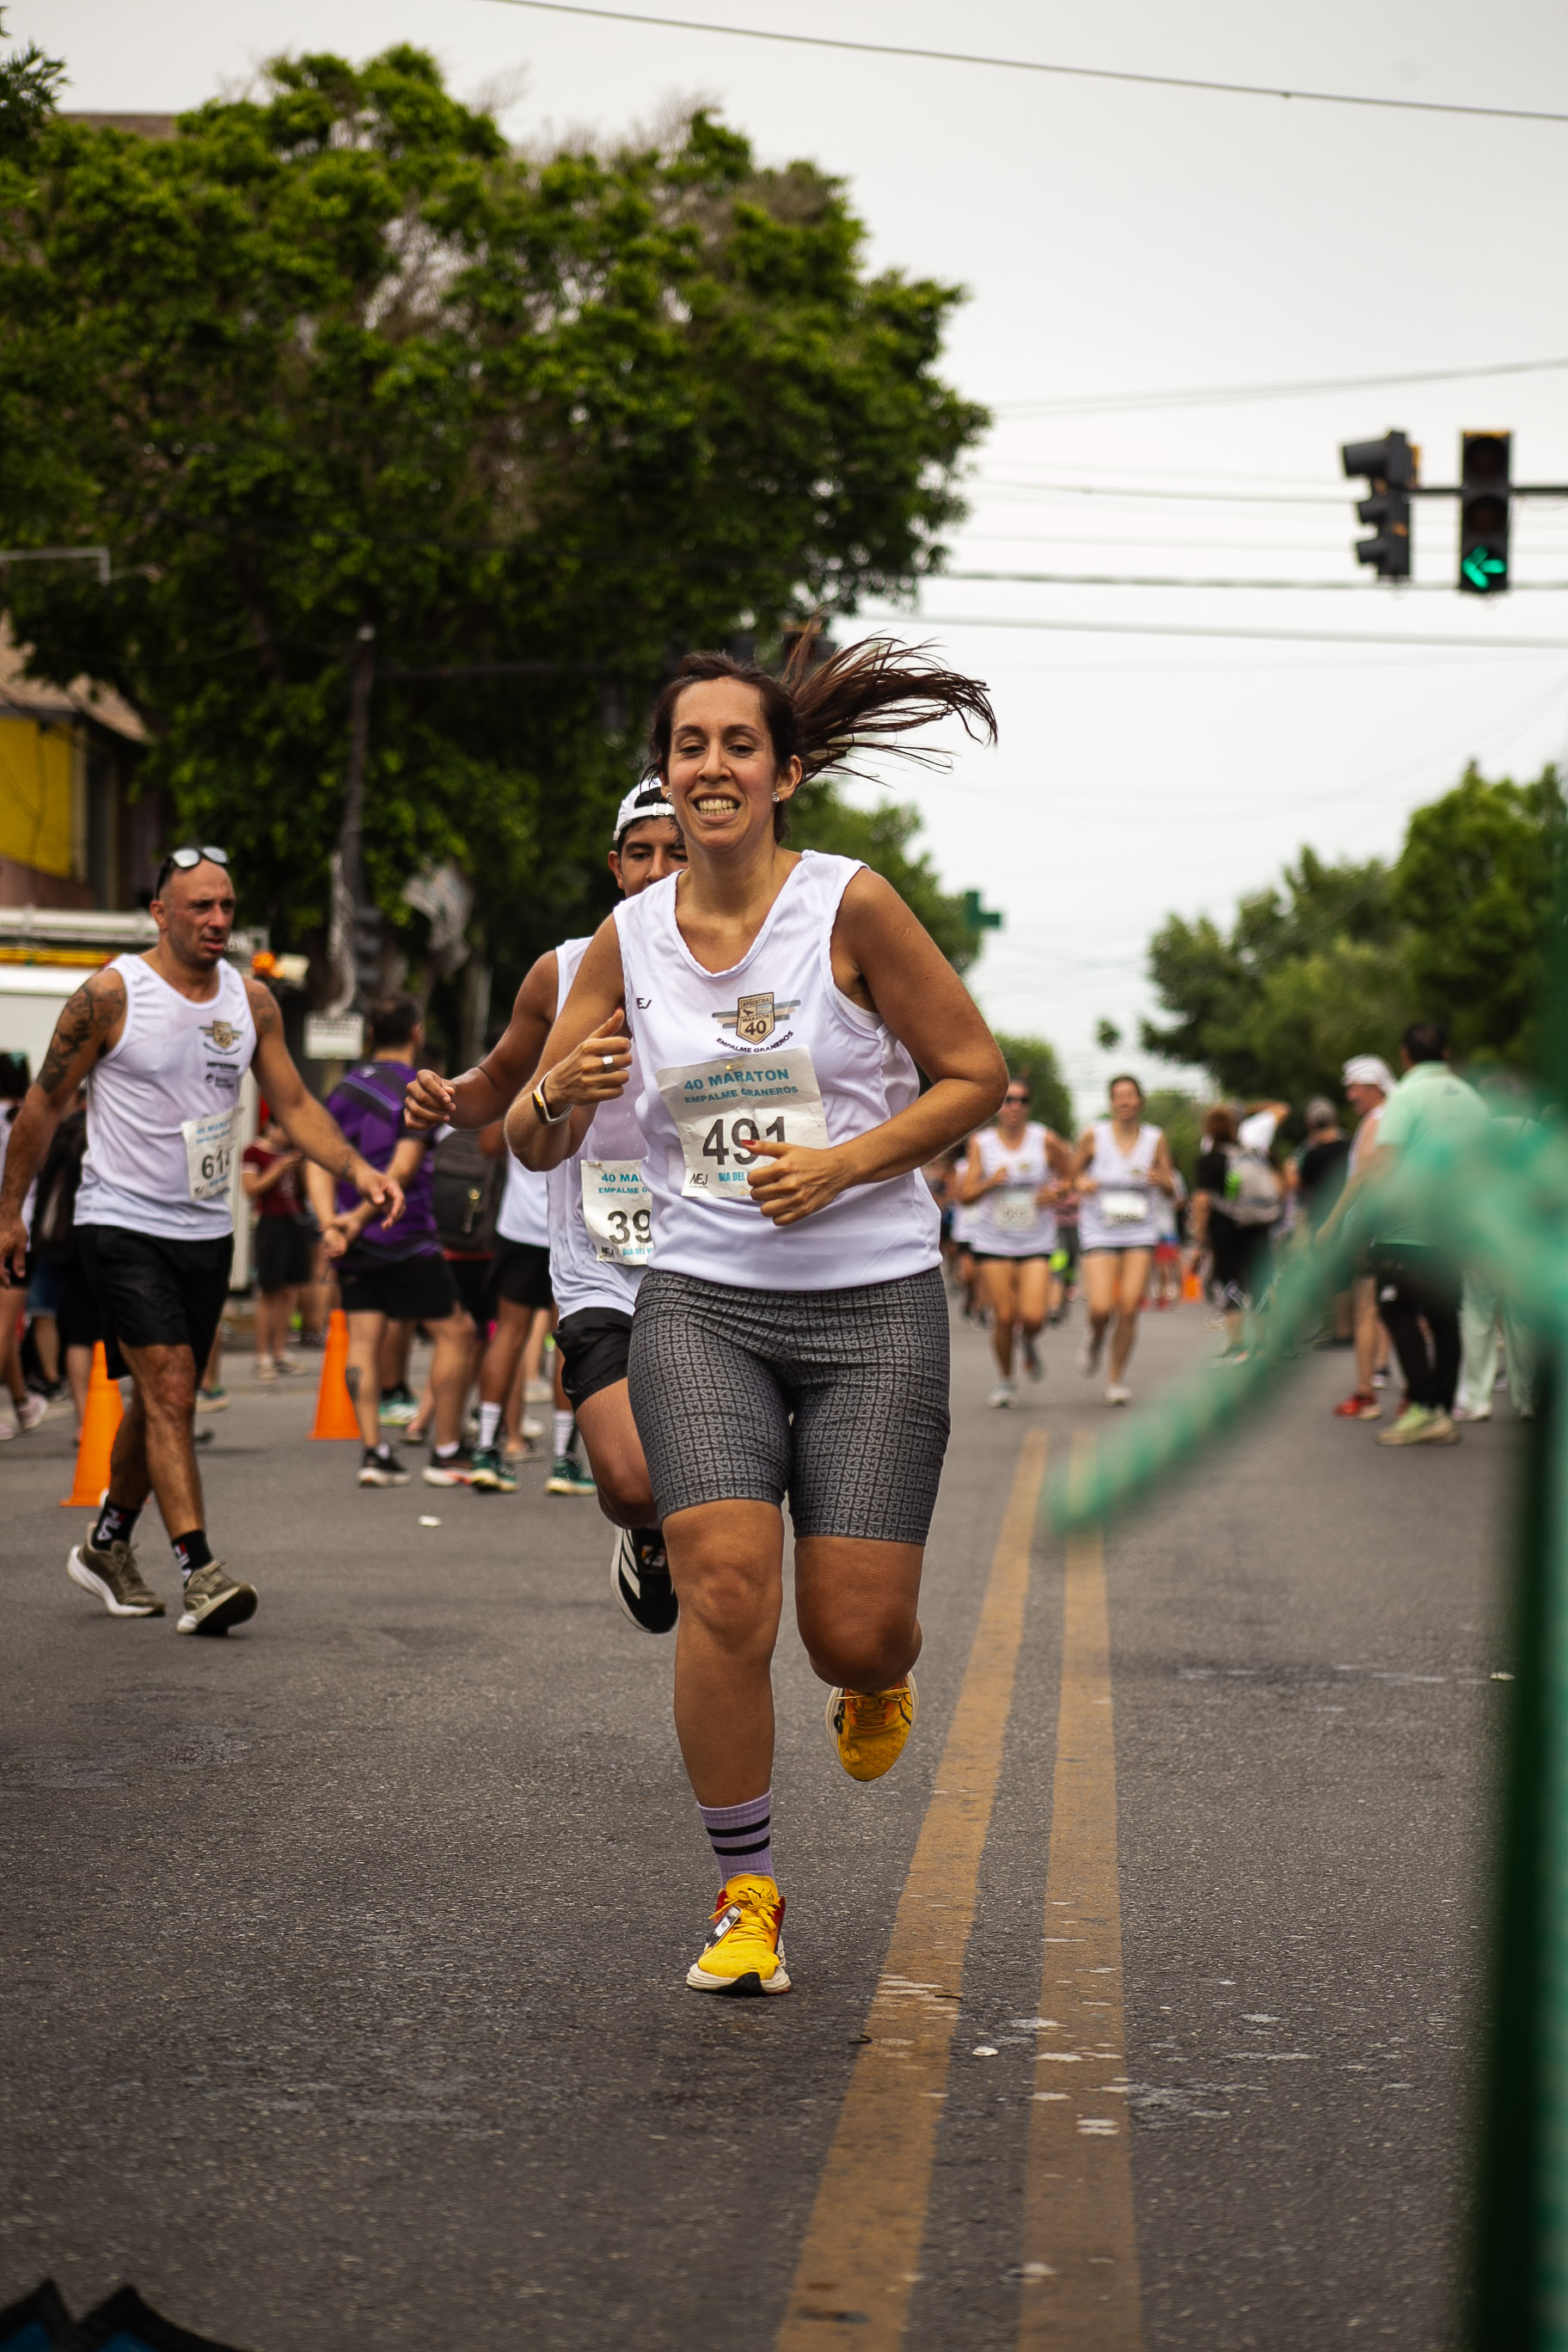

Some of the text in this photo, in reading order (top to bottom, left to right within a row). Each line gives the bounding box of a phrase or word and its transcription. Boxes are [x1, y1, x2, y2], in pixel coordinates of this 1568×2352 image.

[742, 998, 770, 1007] ARGENTINA
[744, 1020, 767, 1036] 40
[716, 1031, 793, 1053] EMPALME GRANEROS
[684, 1069, 789, 1091] 40 MARATON
[684, 1086, 799, 1104] EMPALME GRANEROS
[702, 1116, 786, 1166] 491
[602, 1173, 641, 1183] 40 MA
[719, 1172, 731, 1182] DIA
[732, 1171, 746, 1181] DEL
[608, 1209, 652, 1245] 39
[96, 1508, 126, 1541] FILA
